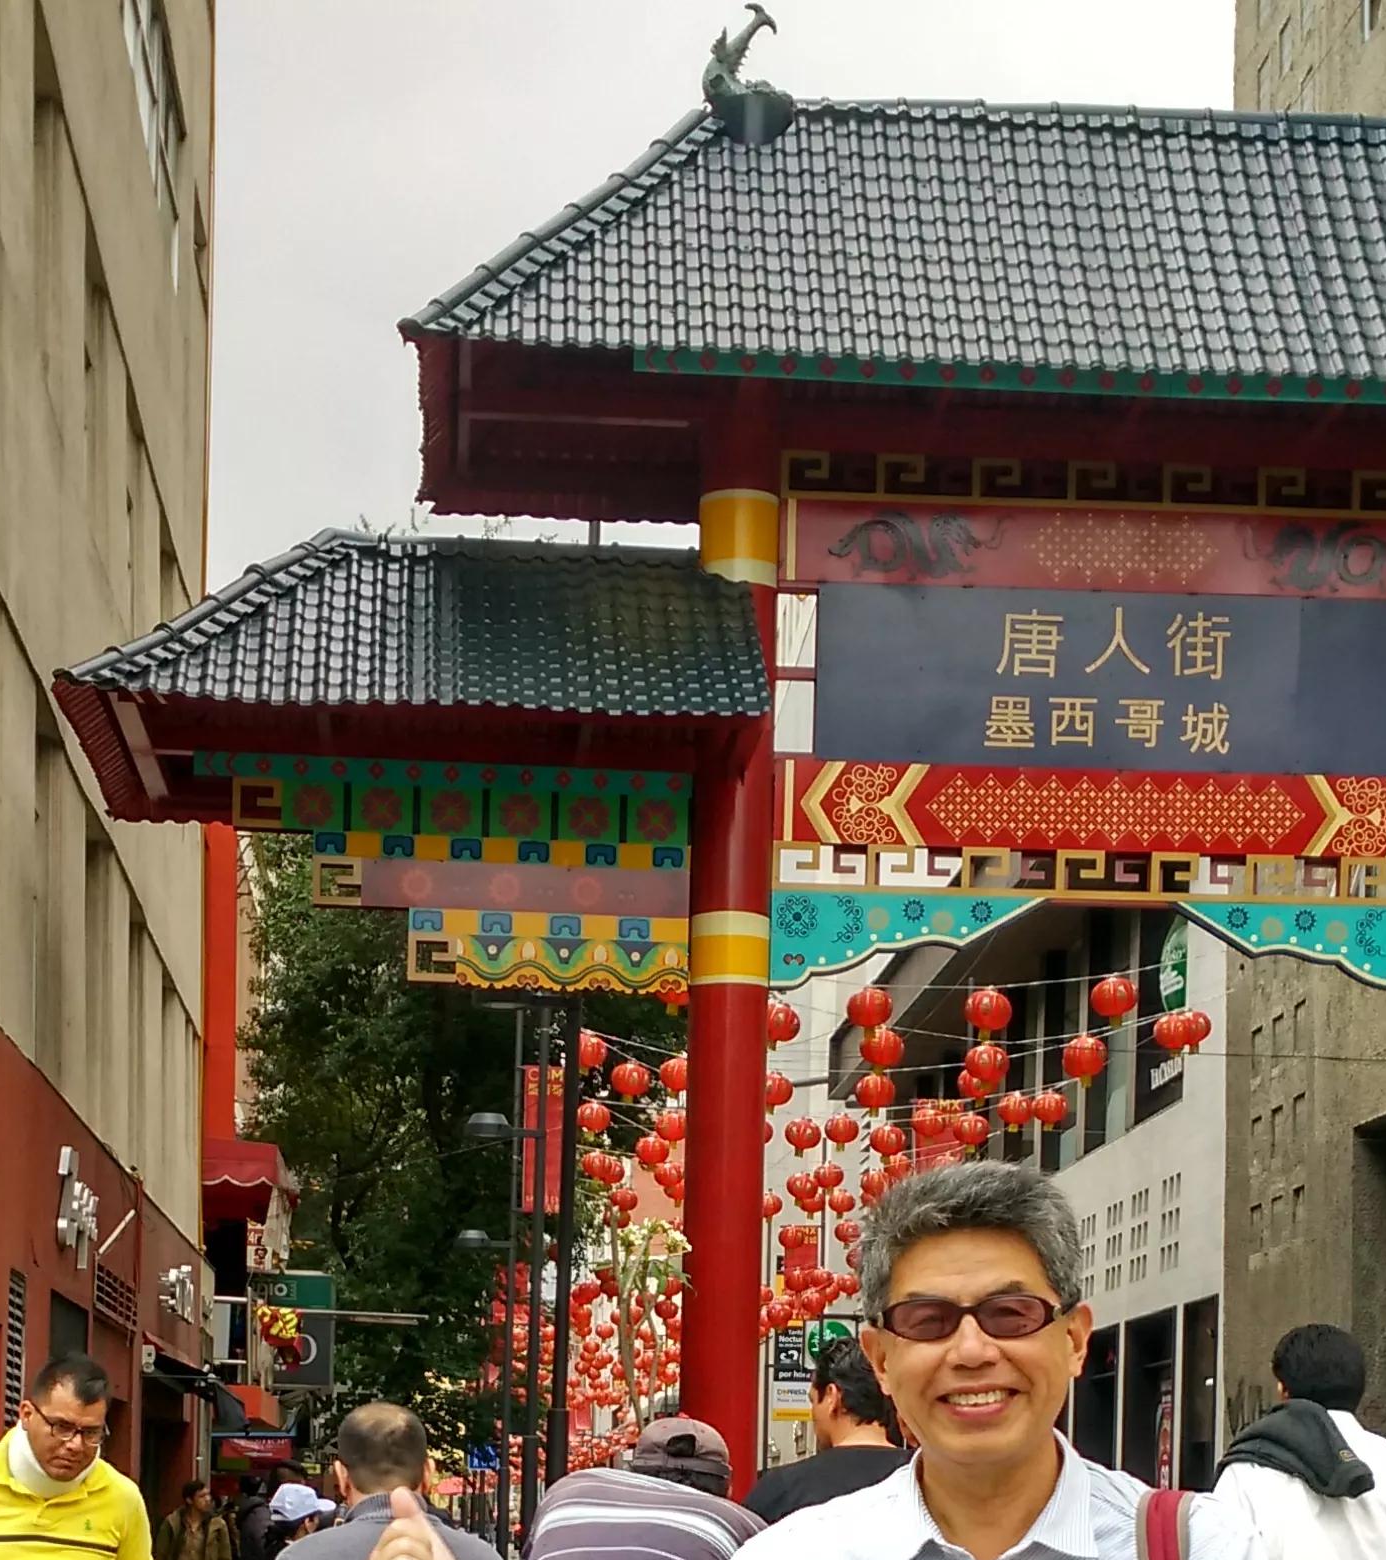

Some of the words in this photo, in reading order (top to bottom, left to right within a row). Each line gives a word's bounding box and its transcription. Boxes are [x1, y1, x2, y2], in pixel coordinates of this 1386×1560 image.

[996, 606, 1232, 681] 唐人街
[984, 694, 1232, 755] 墨西哥城
